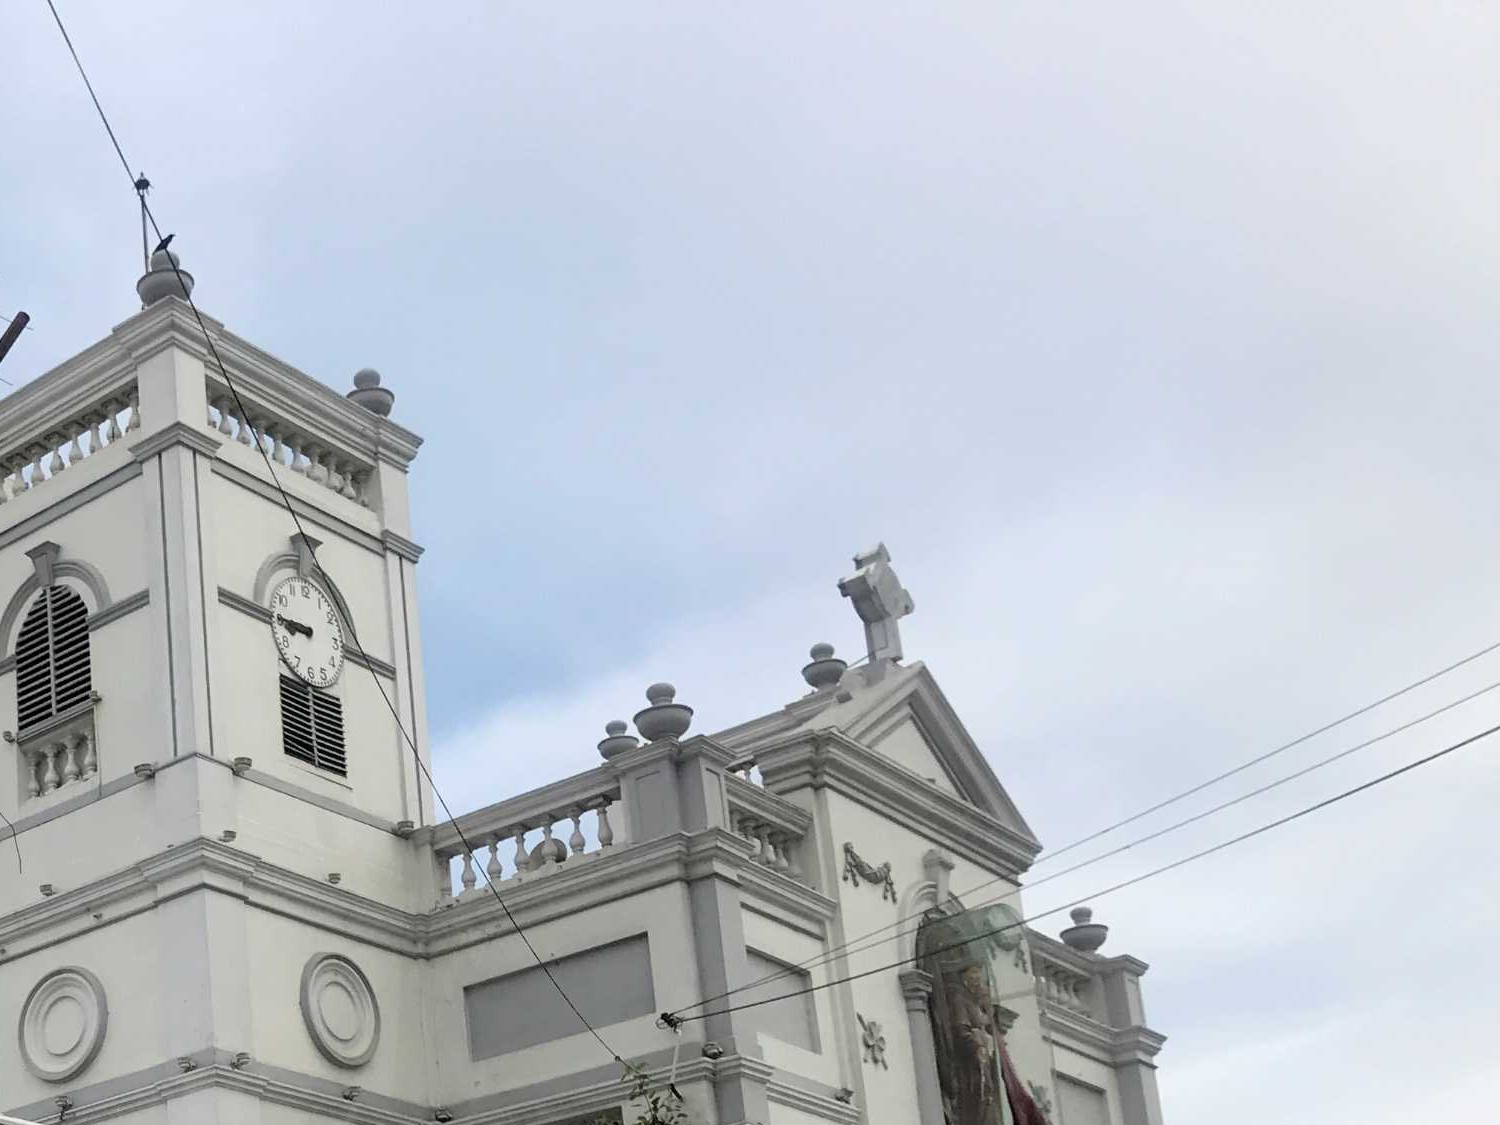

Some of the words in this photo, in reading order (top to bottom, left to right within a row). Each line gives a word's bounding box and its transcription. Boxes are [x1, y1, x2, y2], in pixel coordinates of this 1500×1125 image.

[289, 583, 296, 596] 11
[279, 594, 288, 607] 10
[327, 611, 334, 625] 2
[282, 635, 290, 648] 8
[332, 637, 339, 651] 3
[294, 655, 301, 668] 7
[328, 656, 336, 668] 4
[307, 667, 315, 679] 6
[320, 667, 328, 681] 5
